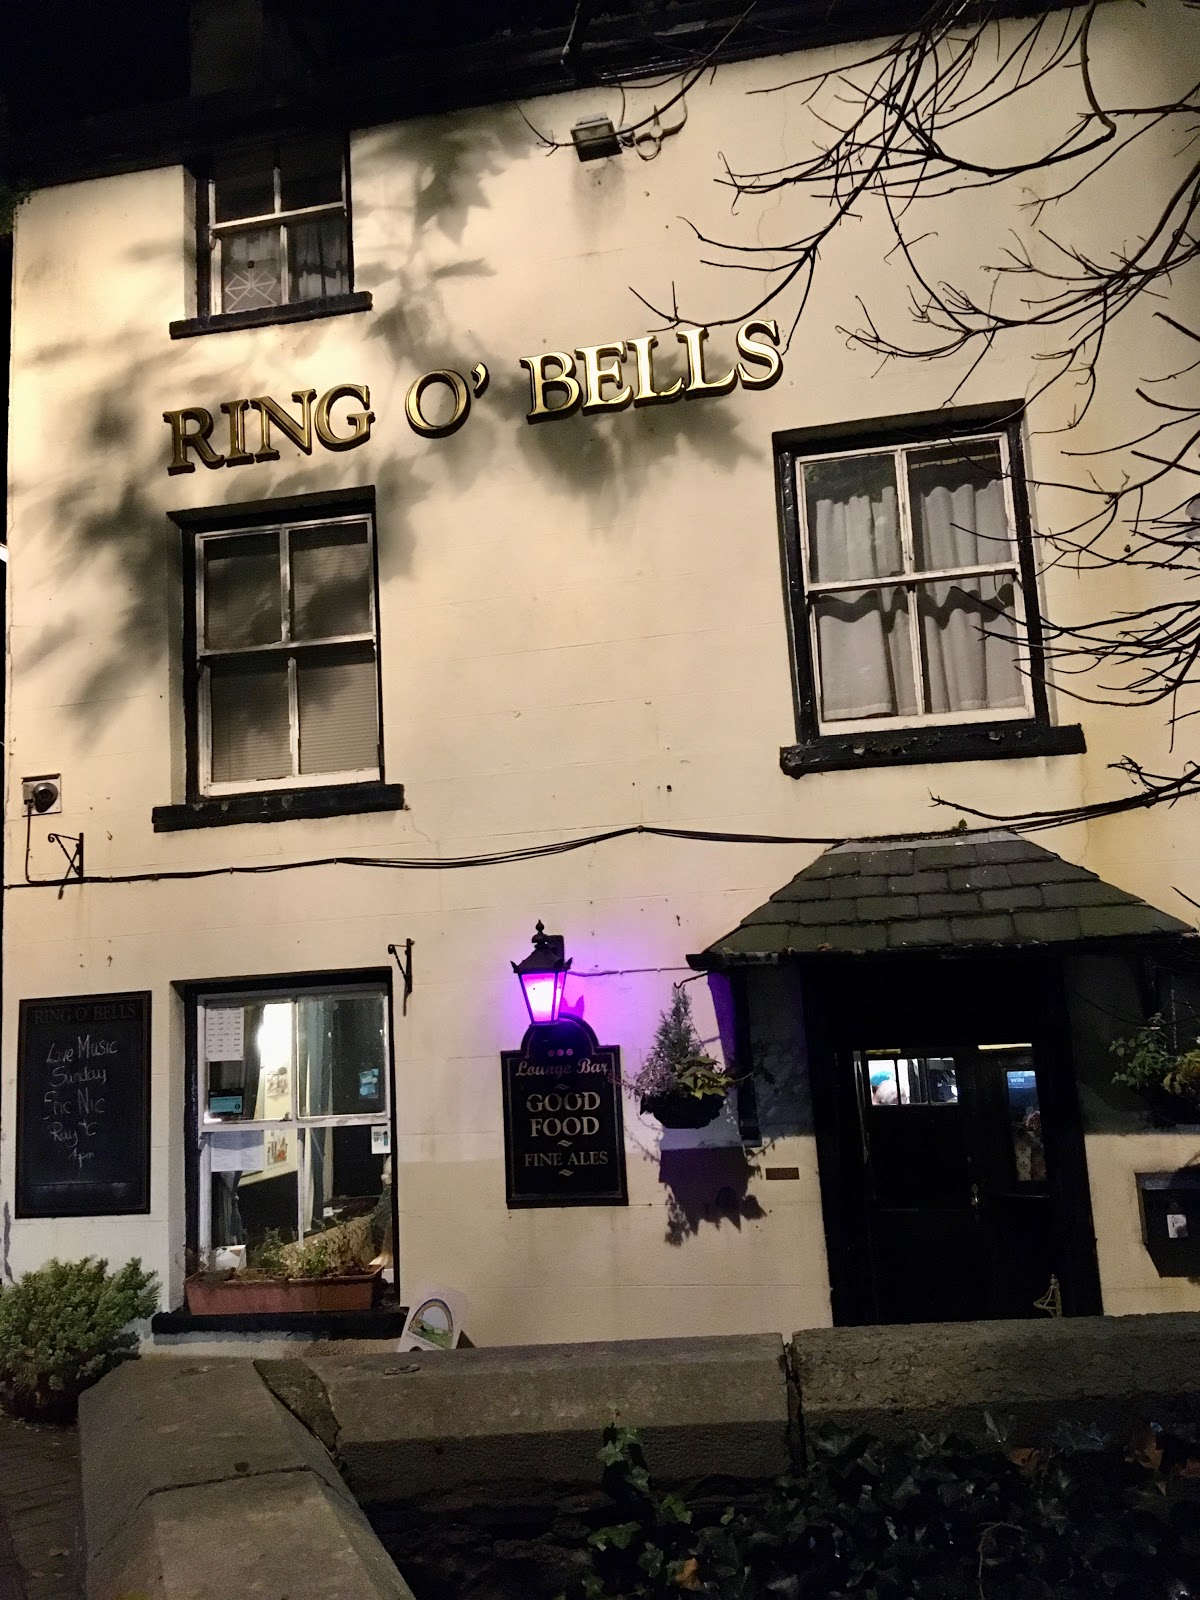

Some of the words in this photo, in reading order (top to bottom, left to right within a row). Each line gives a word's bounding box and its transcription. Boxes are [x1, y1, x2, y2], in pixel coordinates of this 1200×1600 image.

[163, 384, 375, 475] RING
[403, 361, 490, 438] O'
[520, 319, 784, 423] BELLS
[34, 1007, 71, 1024] RING
[93, 1003, 137, 1020] BELLS
[46, 1043, 74, 1063] Live
[78, 1034, 118, 1059] Music
[49, 1066, 107, 1087] Sunday
[515, 1060, 572, 1080] Lounge
[576, 1057, 610, 1075] Bar
[526, 1091, 601, 1113] GOOD
[530, 1116, 600, 1137] FOOD
[524, 1152, 563, 1167] FINE
[567, 1151, 609, 1166] ALES
